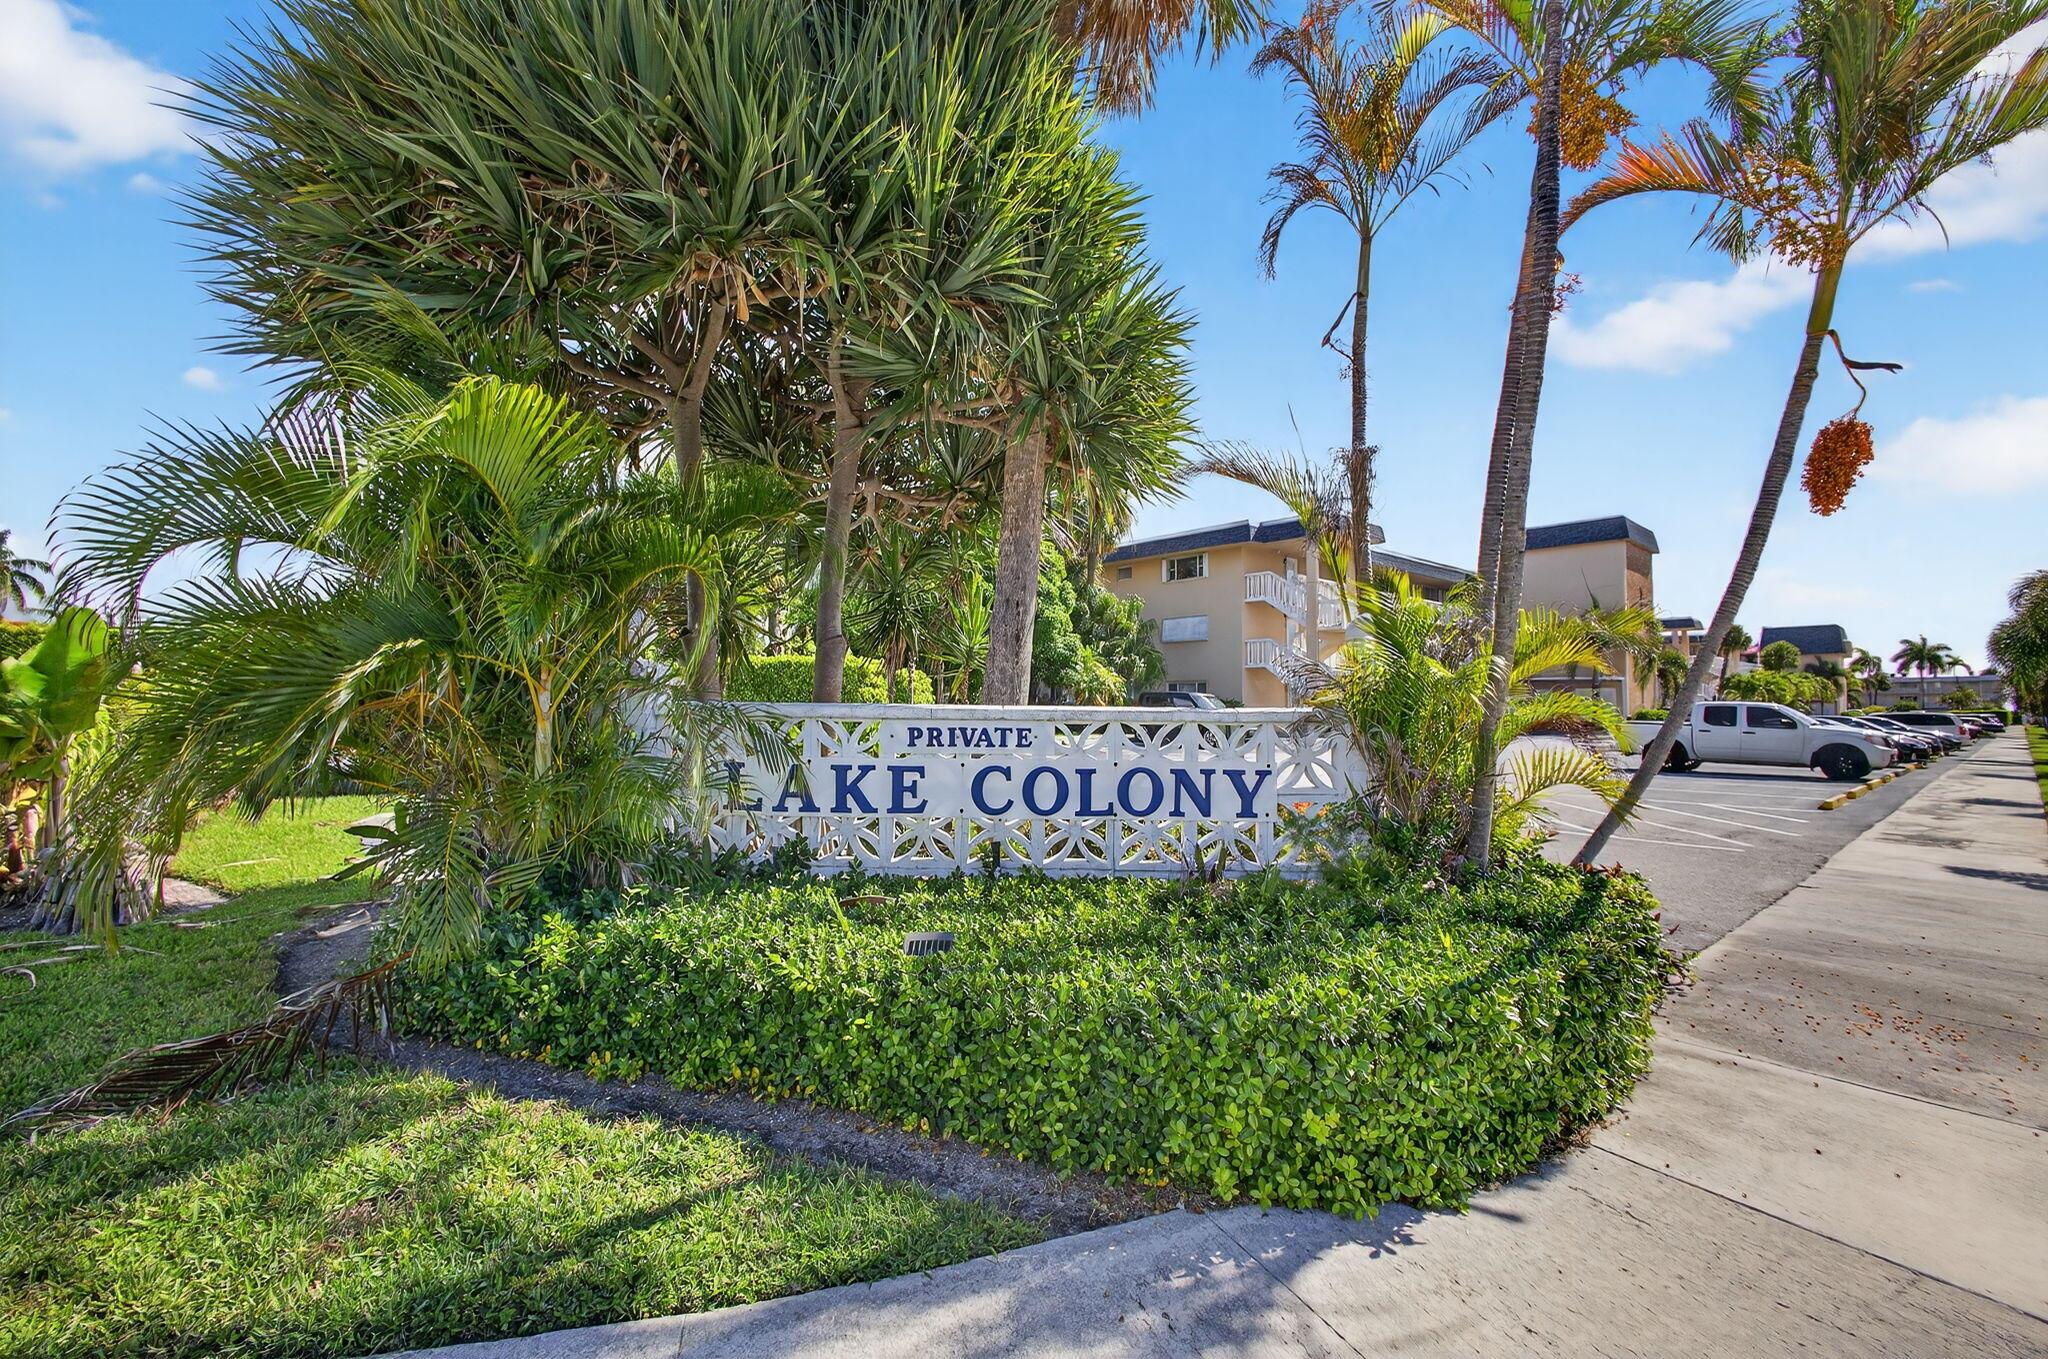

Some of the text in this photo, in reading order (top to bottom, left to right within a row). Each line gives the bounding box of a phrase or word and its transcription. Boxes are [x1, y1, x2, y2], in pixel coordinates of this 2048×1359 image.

[908, 727, 1033, 748] PRIVATE
[723, 761, 1273, 818] LAKE COLONY
